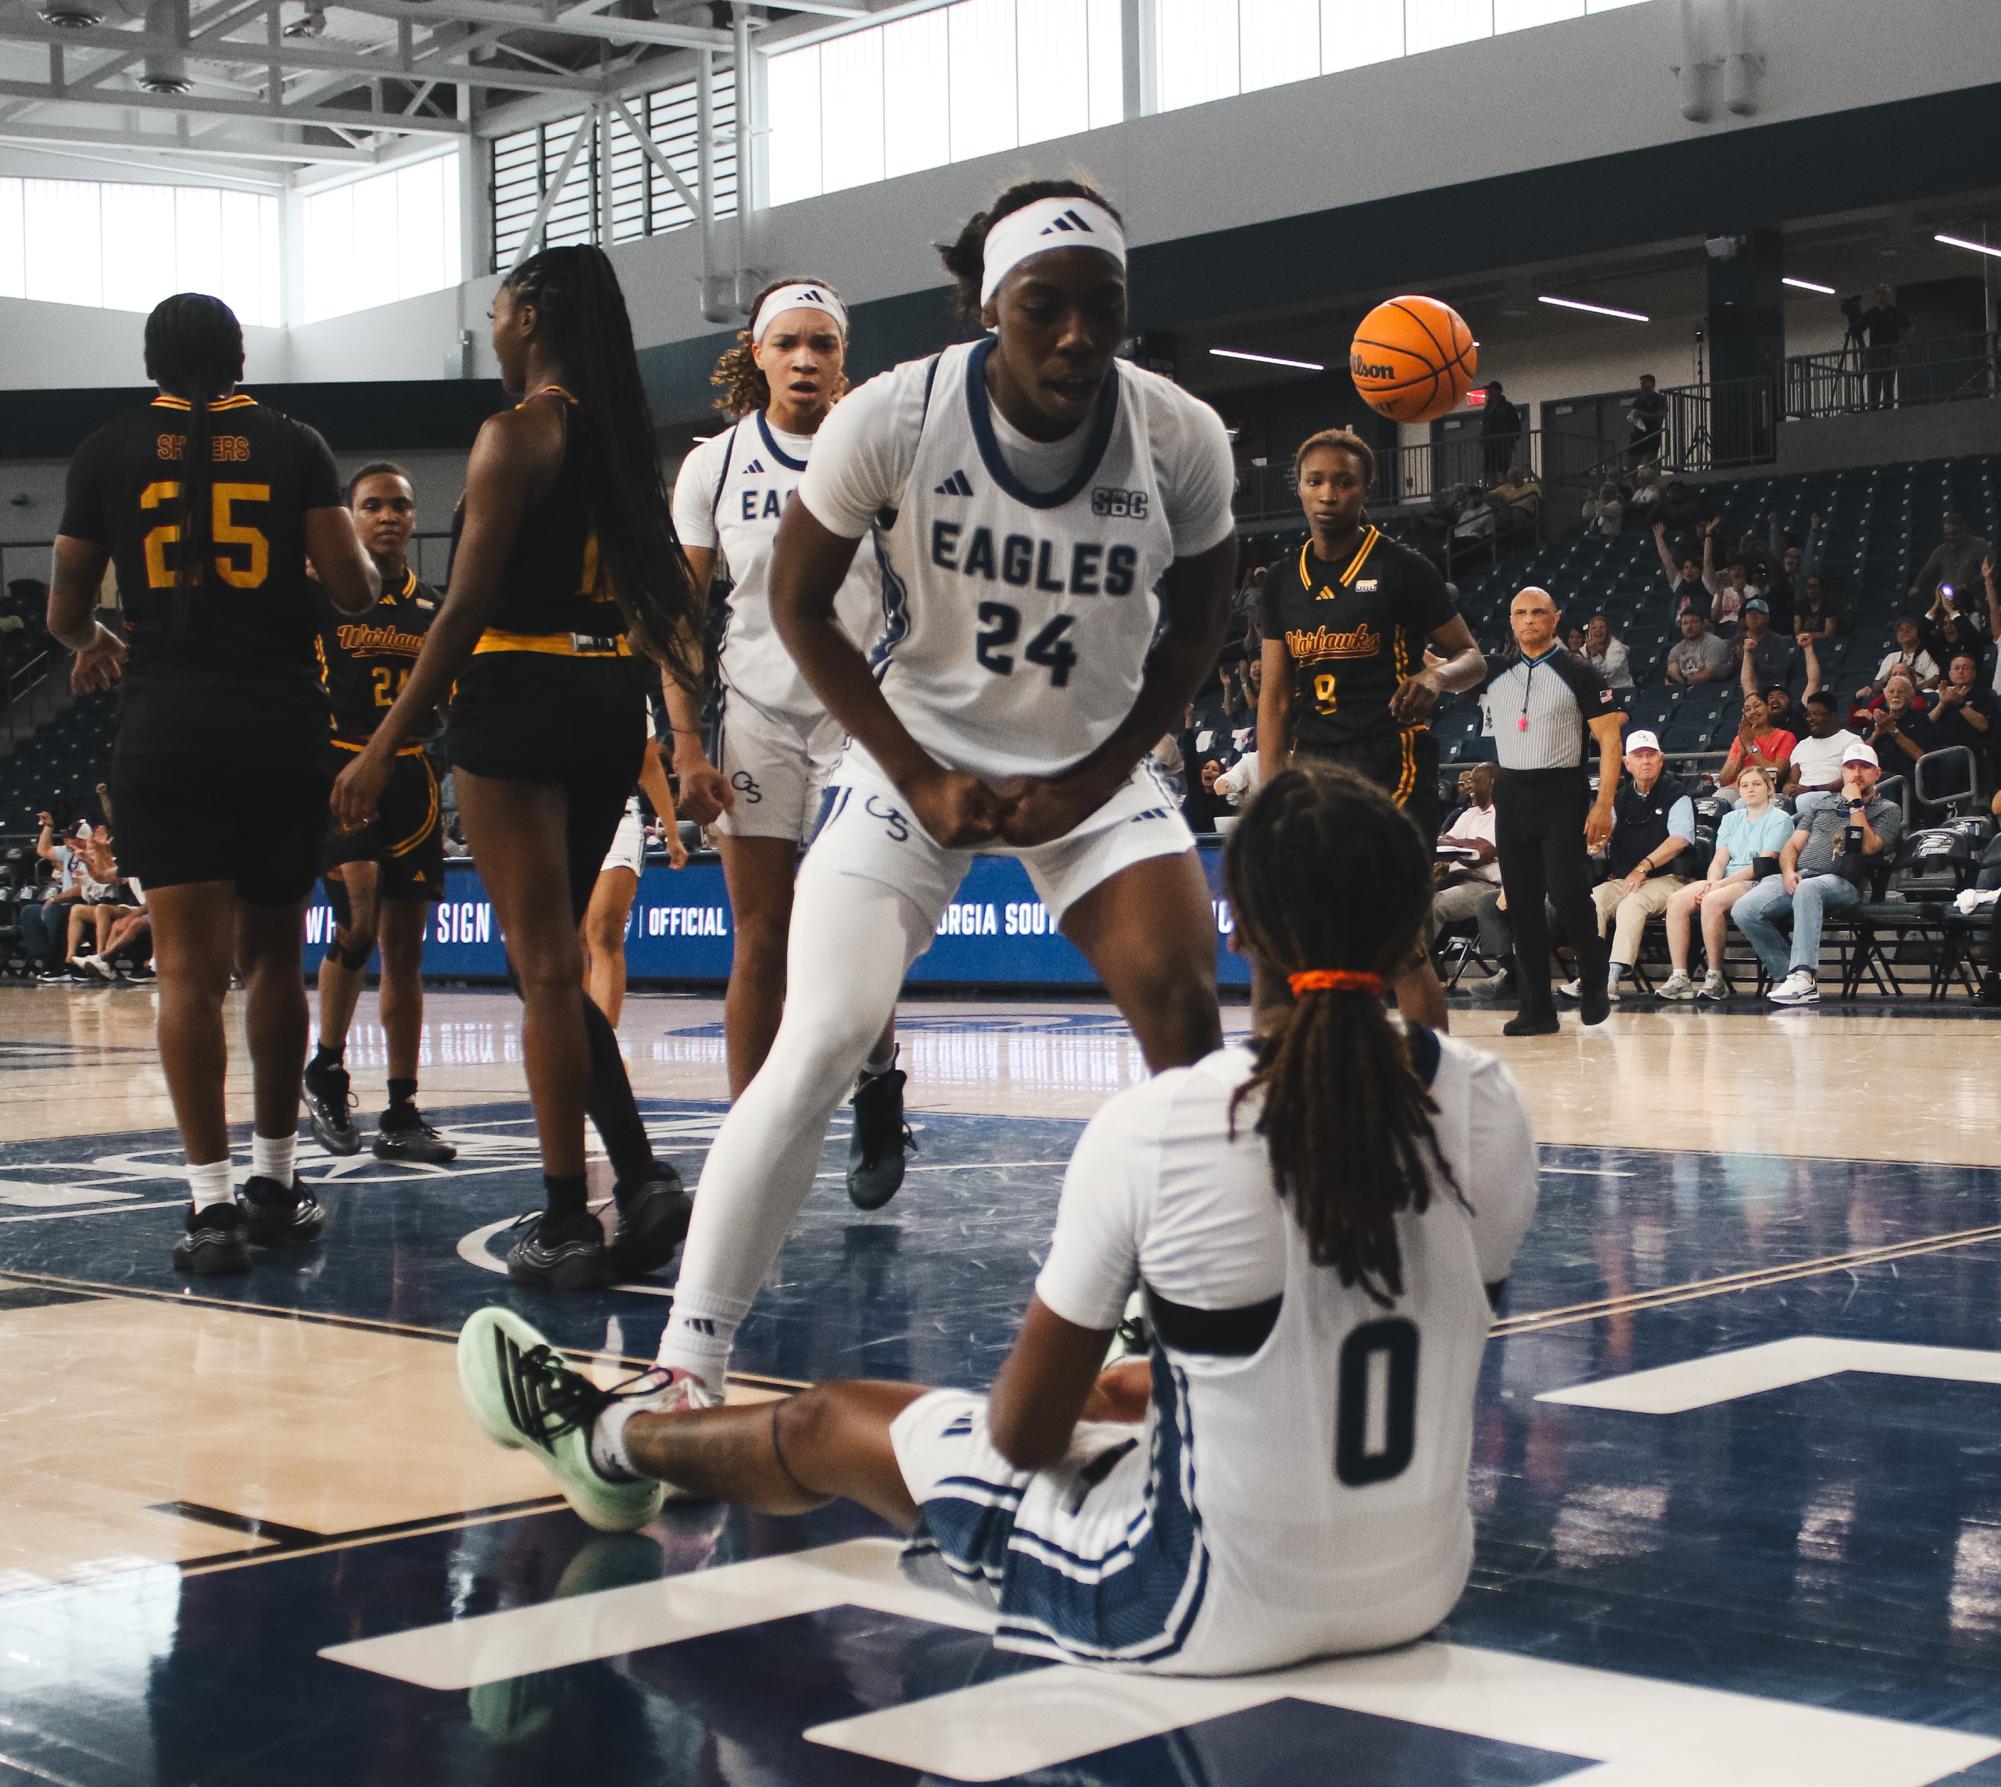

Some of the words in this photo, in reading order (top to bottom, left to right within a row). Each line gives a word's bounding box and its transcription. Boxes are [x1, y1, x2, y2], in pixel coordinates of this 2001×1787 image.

[1350, 355, 1395, 379] ilson
[1091, 487, 1148, 519] SBC
[140, 481, 271, 589] 25
[931, 519, 1137, 597] EAGLES
[976, 601, 1078, 687] 24
[1286, 623, 1380, 664] Warhawks
[436, 903, 491, 944] SIGN
[648, 907, 727, 936] OFFICIAL
[1335, 1316, 1420, 1486] 0
